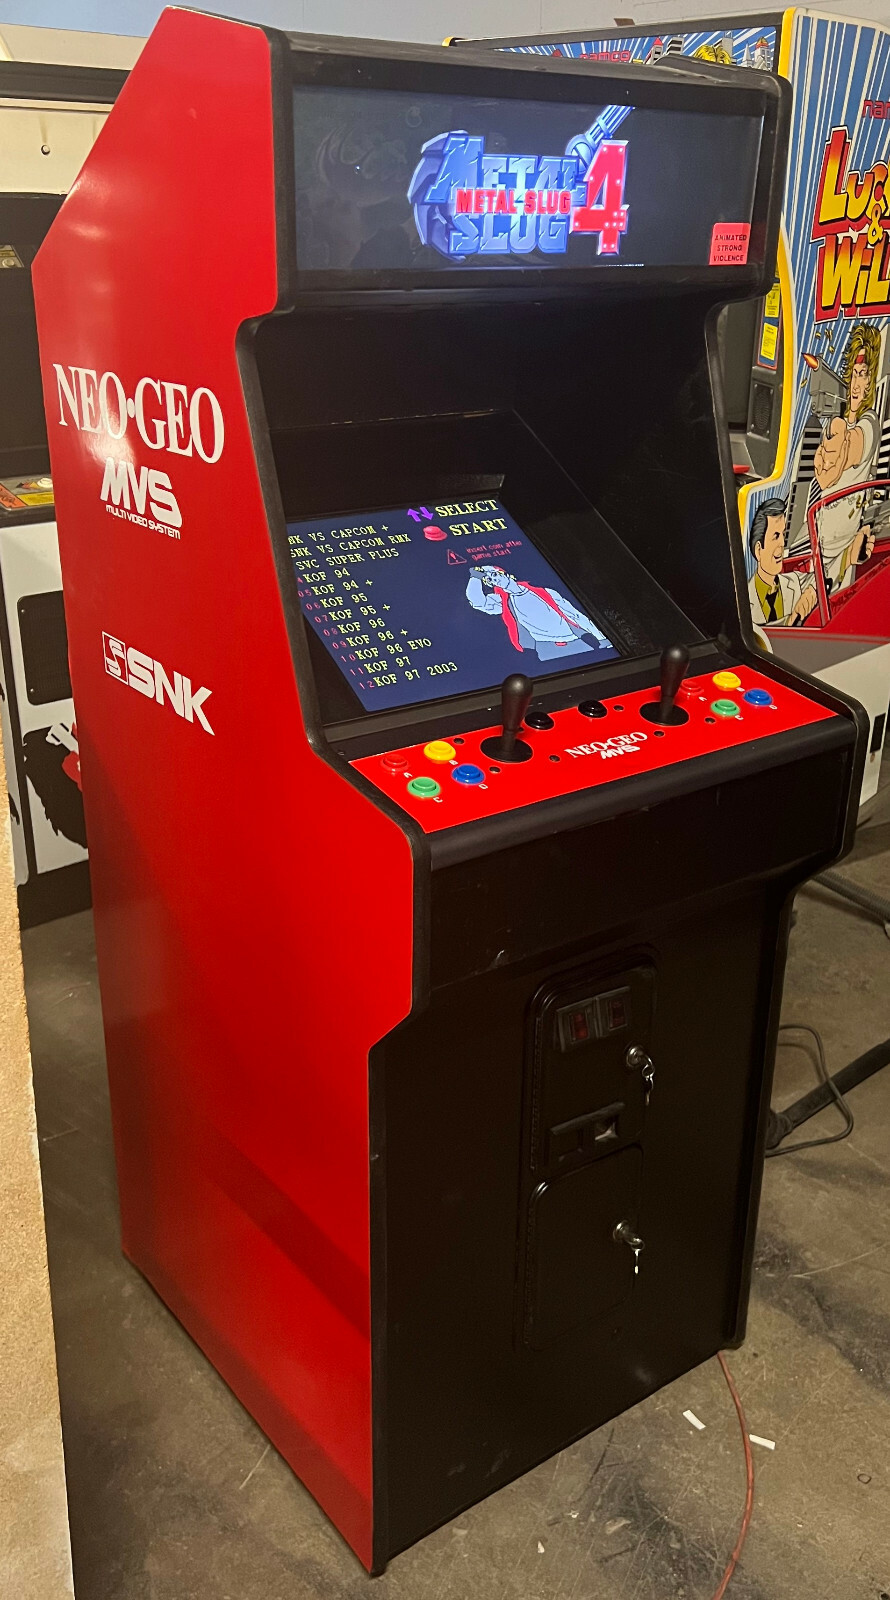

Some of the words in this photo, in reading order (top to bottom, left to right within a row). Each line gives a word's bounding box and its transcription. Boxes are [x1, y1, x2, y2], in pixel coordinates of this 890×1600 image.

[424, 136, 588, 206] METAL
[814, 126, 890, 226] LUC
[456, 189, 517, 215] METAL
[524, 189, 572, 215] SLUG
[571, 139, 630, 256] 4
[449, 212, 568, 254] SLUG
[100, 456, 183, 528] MVS
[435, 500, 499, 518] SELECT
[126, 512, 148, 528] VIDEO
[148, 520, 181, 540] SYSTEM
[288, 534, 304, 545] NK
[308, 532, 326, 542] VS
[330, 525, 377, 539] CAPCOM
[449, 518, 508, 536] START
[290, 546, 312, 558] SNK
[316, 544, 334, 554] VS
[339, 537, 386, 551] CAPCOM
[388, 534, 412, 544] RMX
[296, 559, 320, 570] SVC
[326, 552, 366, 566] SUPER
[368, 548, 400, 560] PLUS
[302, 571, 326, 583] KOF
[334, 567, 350, 578] 94
[310, 584, 335, 596] KOF
[342, 580, 359, 591] 94
[320, 596, 344, 608] KOF
[351, 592, 368, 604] 95
[328, 608, 352, 621] KOF
[360, 605, 377, 616] 95
[337, 622, 361, 634] KOF
[368, 618, 386, 629] 96
[346, 634, 370, 647] KOF
[378, 630, 394, 642] 96
[354, 647, 379, 660] KOF
[386, 643, 404, 654] 96
[407, 638, 432, 650] EVO
[364, 660, 388, 674] KOF
[396, 656, 412, 668] 97
[373, 673, 398, 687] KOF
[404, 669, 420, 681] 97
[426, 662, 458, 676] 2003
[127, 646, 216, 736] SNK
[600, 744, 640, 760] MVS
